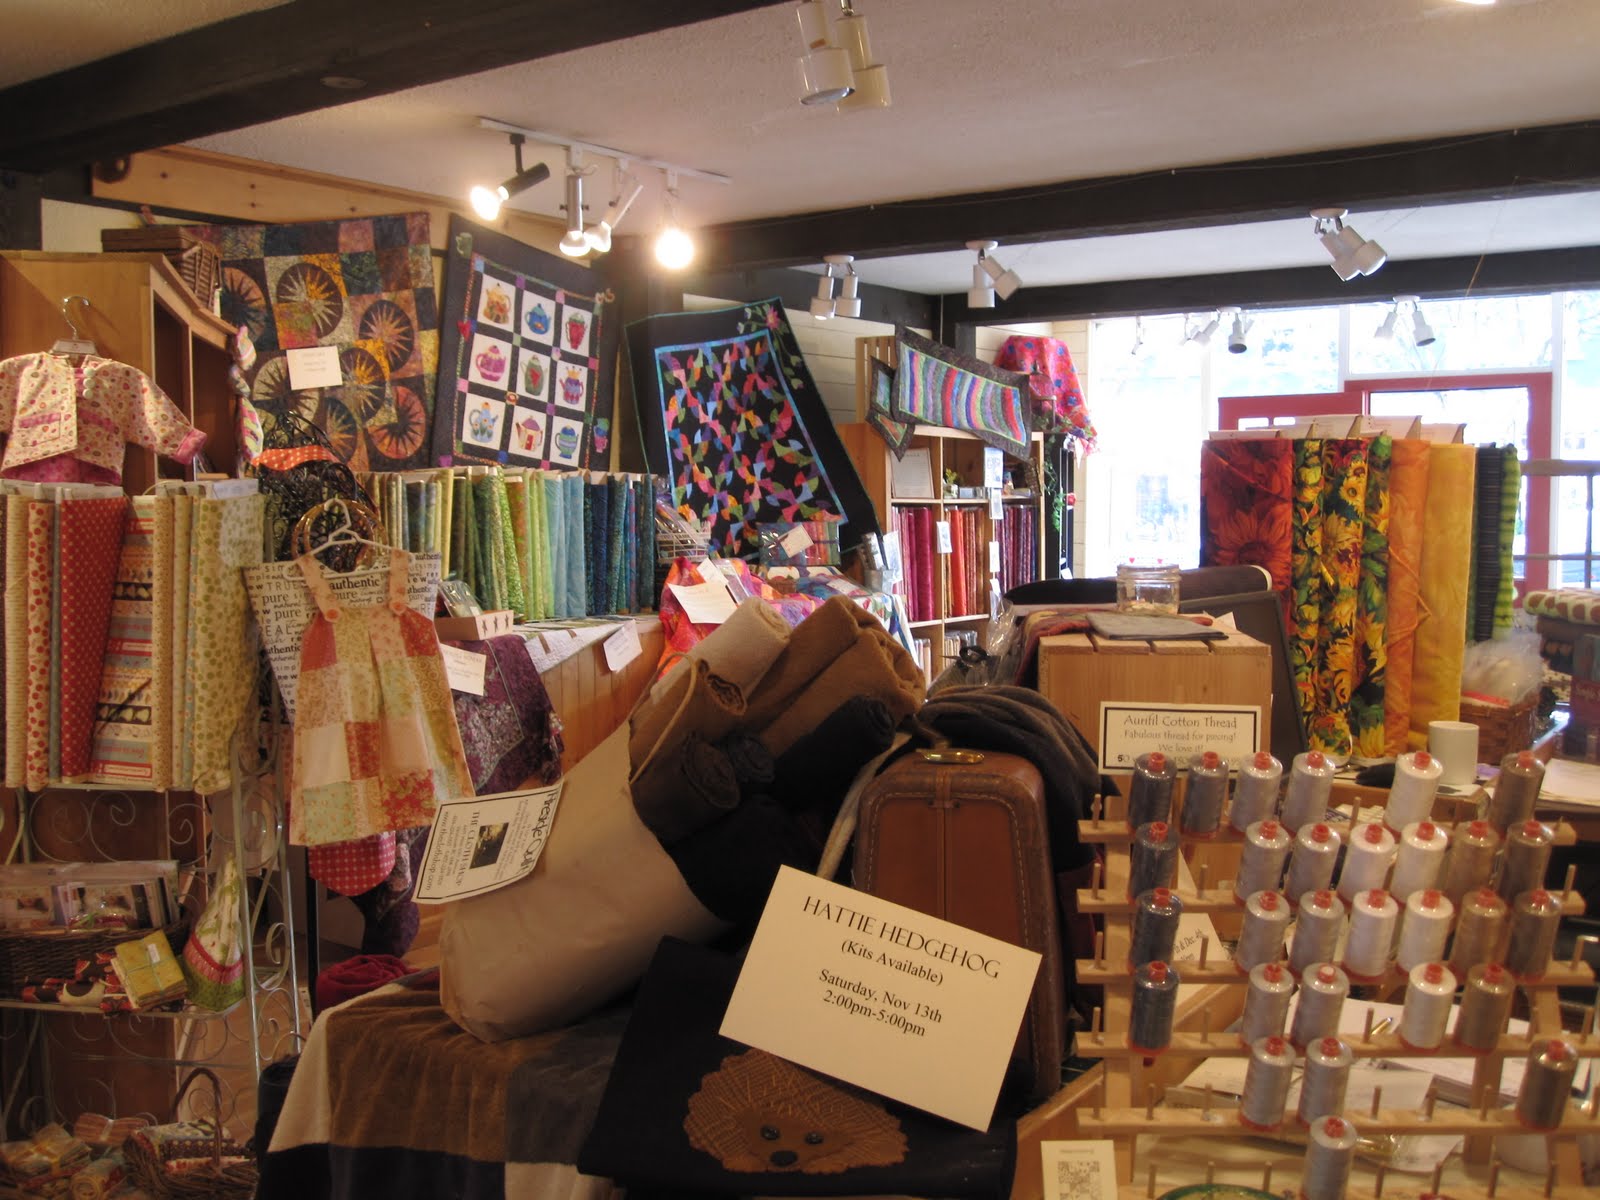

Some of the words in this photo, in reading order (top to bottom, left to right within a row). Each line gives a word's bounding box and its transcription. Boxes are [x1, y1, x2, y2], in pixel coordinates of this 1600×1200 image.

[266, 580, 299, 592] TRUE
[329, 576, 380, 591] authentic
[262, 592, 290, 606] pure
[274, 608, 302, 621] pure
[1162, 715, 1200, 728] Cotton
[1204, 716, 1237, 729] Thread
[1124, 730, 1161, 739] Fabulous
[1164, 731, 1190, 741] thread
[1192, 732, 1204, 741] for
[1158, 743, 1174, 752] We
[1175, 744, 1193, 752] love
[803, 895, 877, 935] HATTIE
[879, 922, 1002, 979] HEDGEHOG
[841, 939, 874, 961] (Kits
[876, 951, 944, 986] Available)
[818, 968, 879, 1001] Saturday,
[882, 993, 911, 1012] Nov
[914, 1002, 943, 1024] 13th
[822, 989, 927, 1037] 2:00pm-5:00pm
